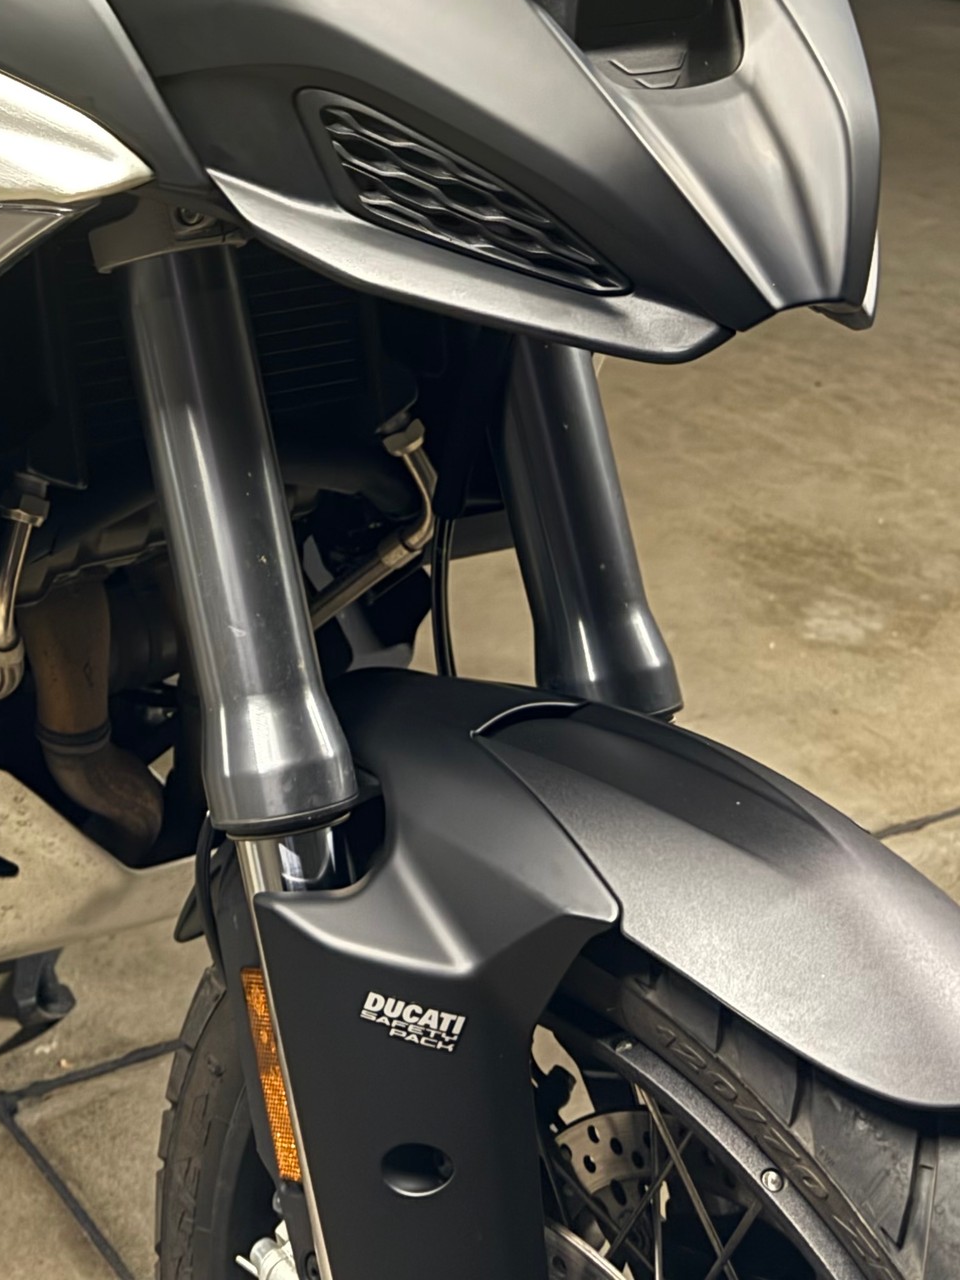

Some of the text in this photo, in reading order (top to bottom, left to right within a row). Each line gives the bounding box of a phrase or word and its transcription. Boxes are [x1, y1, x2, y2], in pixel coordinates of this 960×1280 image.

[360, 1009, 458, 1042] SAFETY
[363, 991, 466, 1035] DUCATI
[389, 1028, 455, 1052] PACK
[655, 1023, 829, 1200] 120/70
